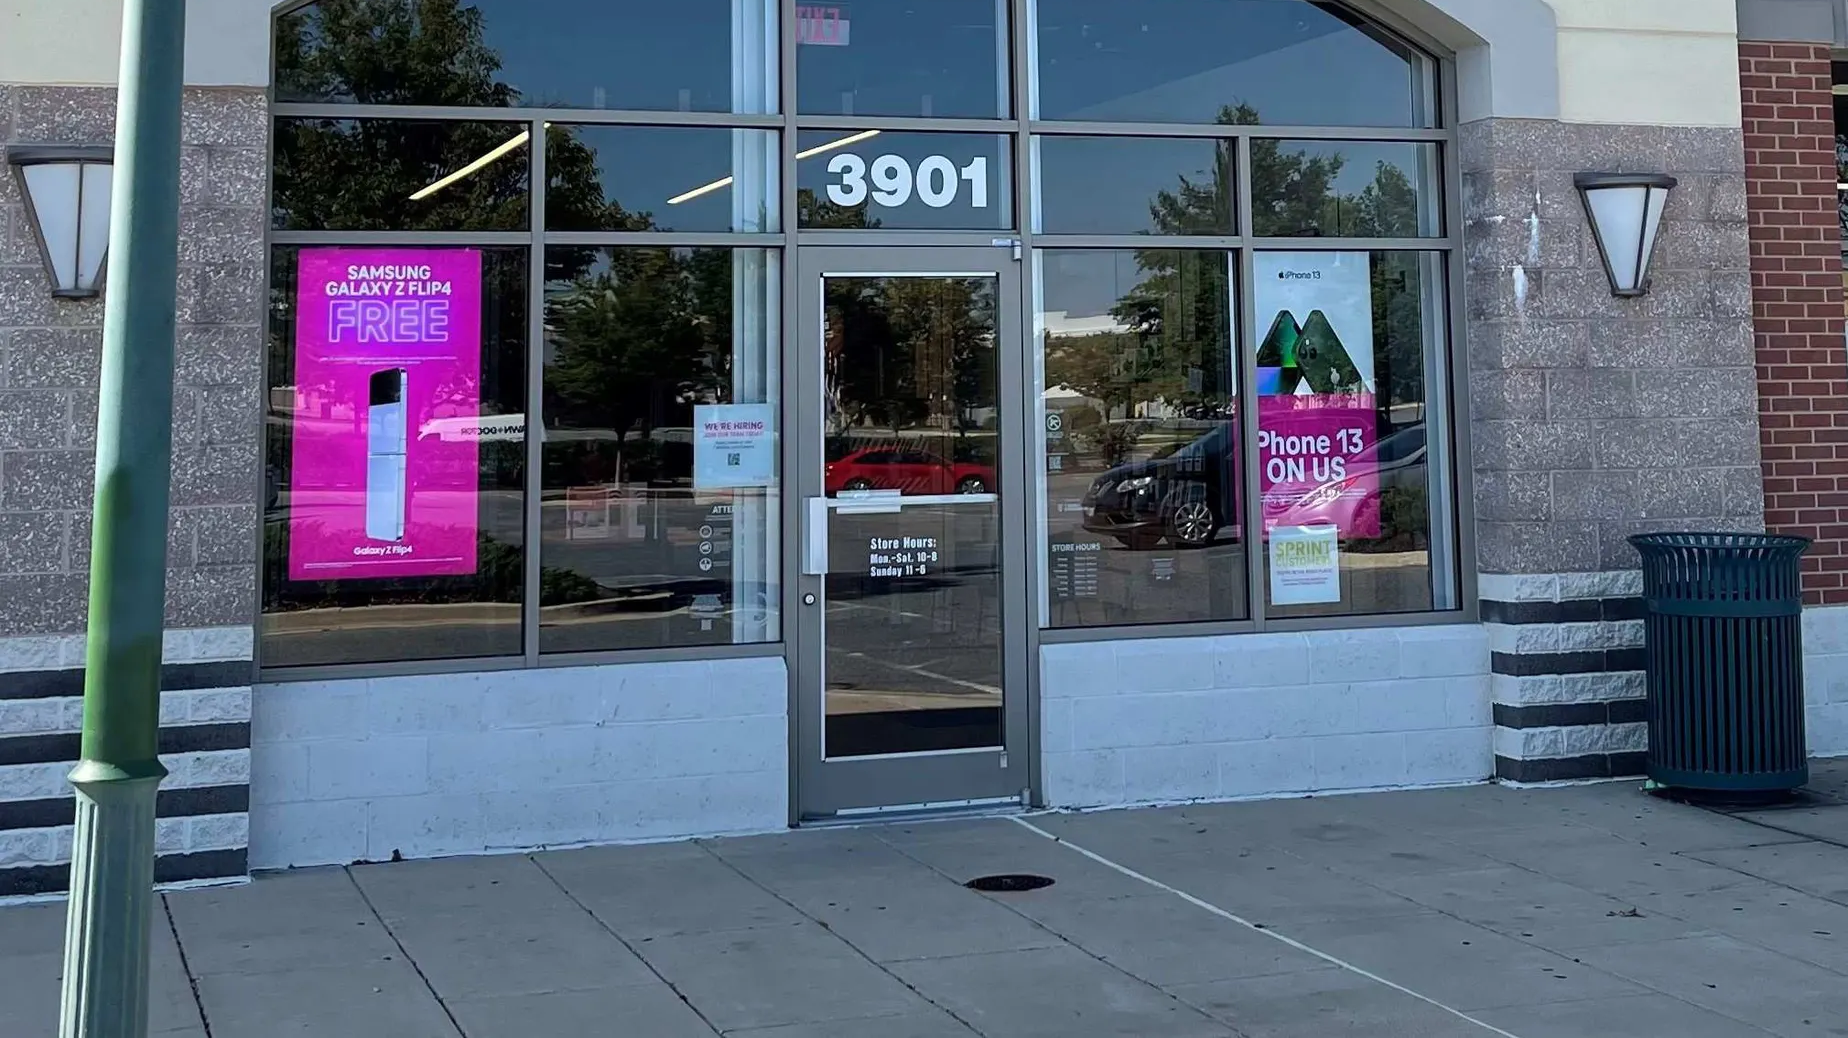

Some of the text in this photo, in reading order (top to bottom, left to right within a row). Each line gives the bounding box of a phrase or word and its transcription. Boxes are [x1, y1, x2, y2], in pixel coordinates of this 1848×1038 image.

[826, 153, 988, 208] 3901
[347, 265, 431, 280] SAMSUNG
[1312, 270, 1321, 279] 13
[325, 281, 452, 296] GALAXY Z FLIP4
[328, 299, 450, 343] FREE
[733, 421, 764, 430] HIRING
[1258, 428, 1364, 455] Phone 13
[1266, 456, 1346, 484] ON US
[711, 505, 735, 514] ATTE
[870, 536, 937, 550] Store Hours:
[1051, 542, 1101, 552] STORE HOURS
[1275, 540, 1333, 557] SPRINT
[353, 545, 413, 556] Galaxy Z Flip4
[870, 566, 902, 578] Sunday
